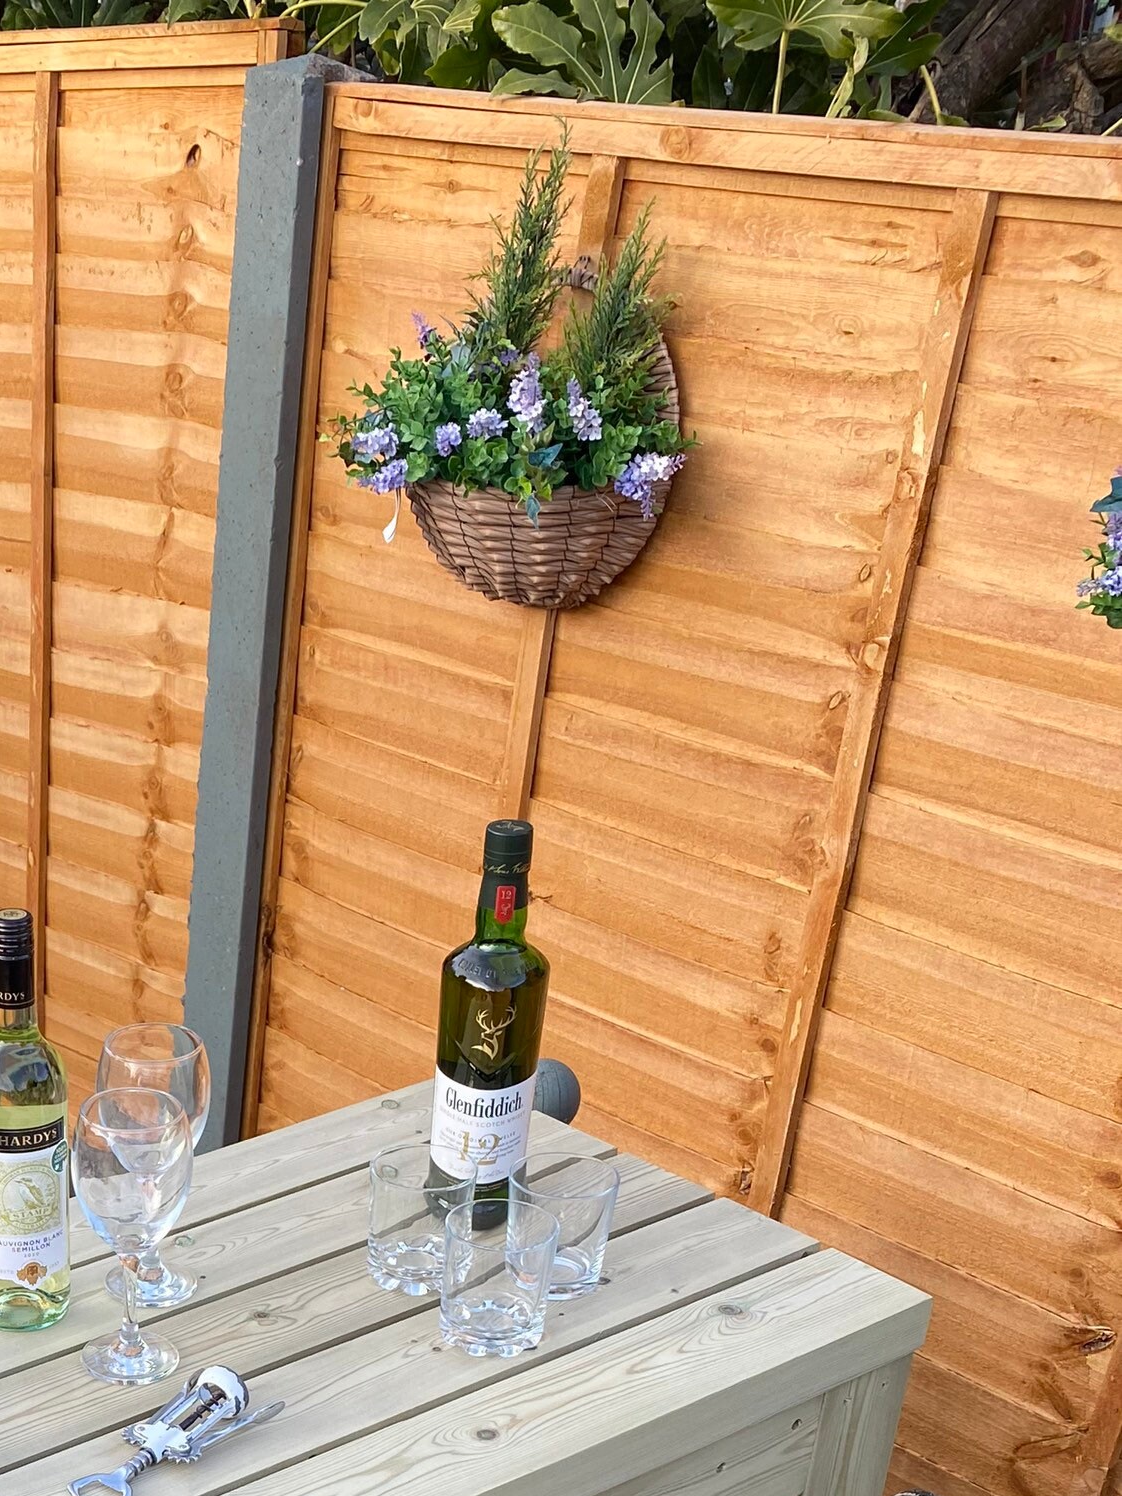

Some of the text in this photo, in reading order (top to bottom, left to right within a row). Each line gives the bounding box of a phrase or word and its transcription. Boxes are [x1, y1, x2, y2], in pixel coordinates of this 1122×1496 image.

[500, 889, 512, 901] 12
[445, 1086, 523, 1119] Glenfiddich
[475, 1119, 506, 1128] SCOTCH
[457, 1130, 503, 1166] 12
[12, 1206, 50, 1218] STAMP
[42, 1228, 64, 1243] BLANC
[11, 1241, 52, 1253] SEMILLON
